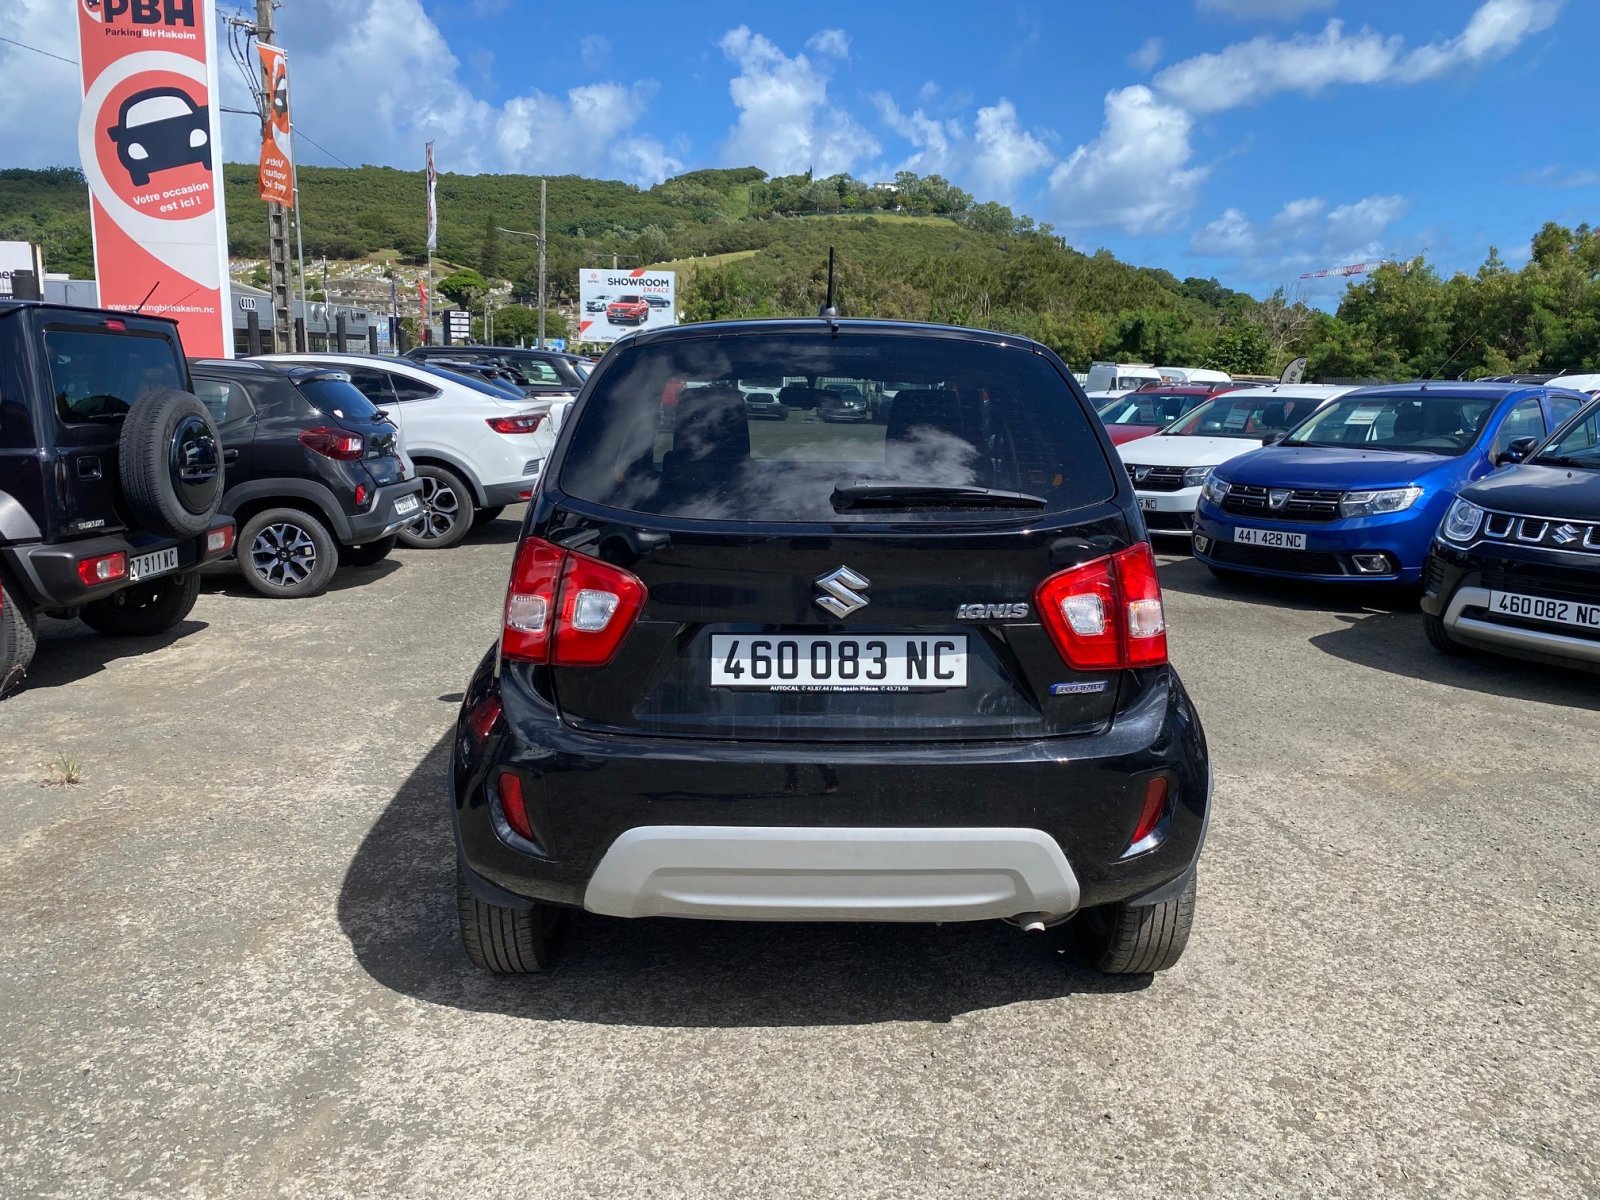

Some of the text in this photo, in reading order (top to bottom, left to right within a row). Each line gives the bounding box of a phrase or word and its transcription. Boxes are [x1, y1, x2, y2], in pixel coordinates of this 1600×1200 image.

[104, 0, 195, 27] PBH
[133, 183, 209, 205] Votre occasion
[160, 201, 178, 212] est
[180, 197, 195, 208] ici
[607, 278, 670, 287] SHOWROOM
[1145, 499, 1156, 509] NC
[1238, 529, 1302, 548] 441 428 NC
[164, 551, 175, 567] NC
[957, 603, 1030, 619] IGNIS
[1576, 605, 1600, 625] NC
[906, 640, 955, 680] NC
